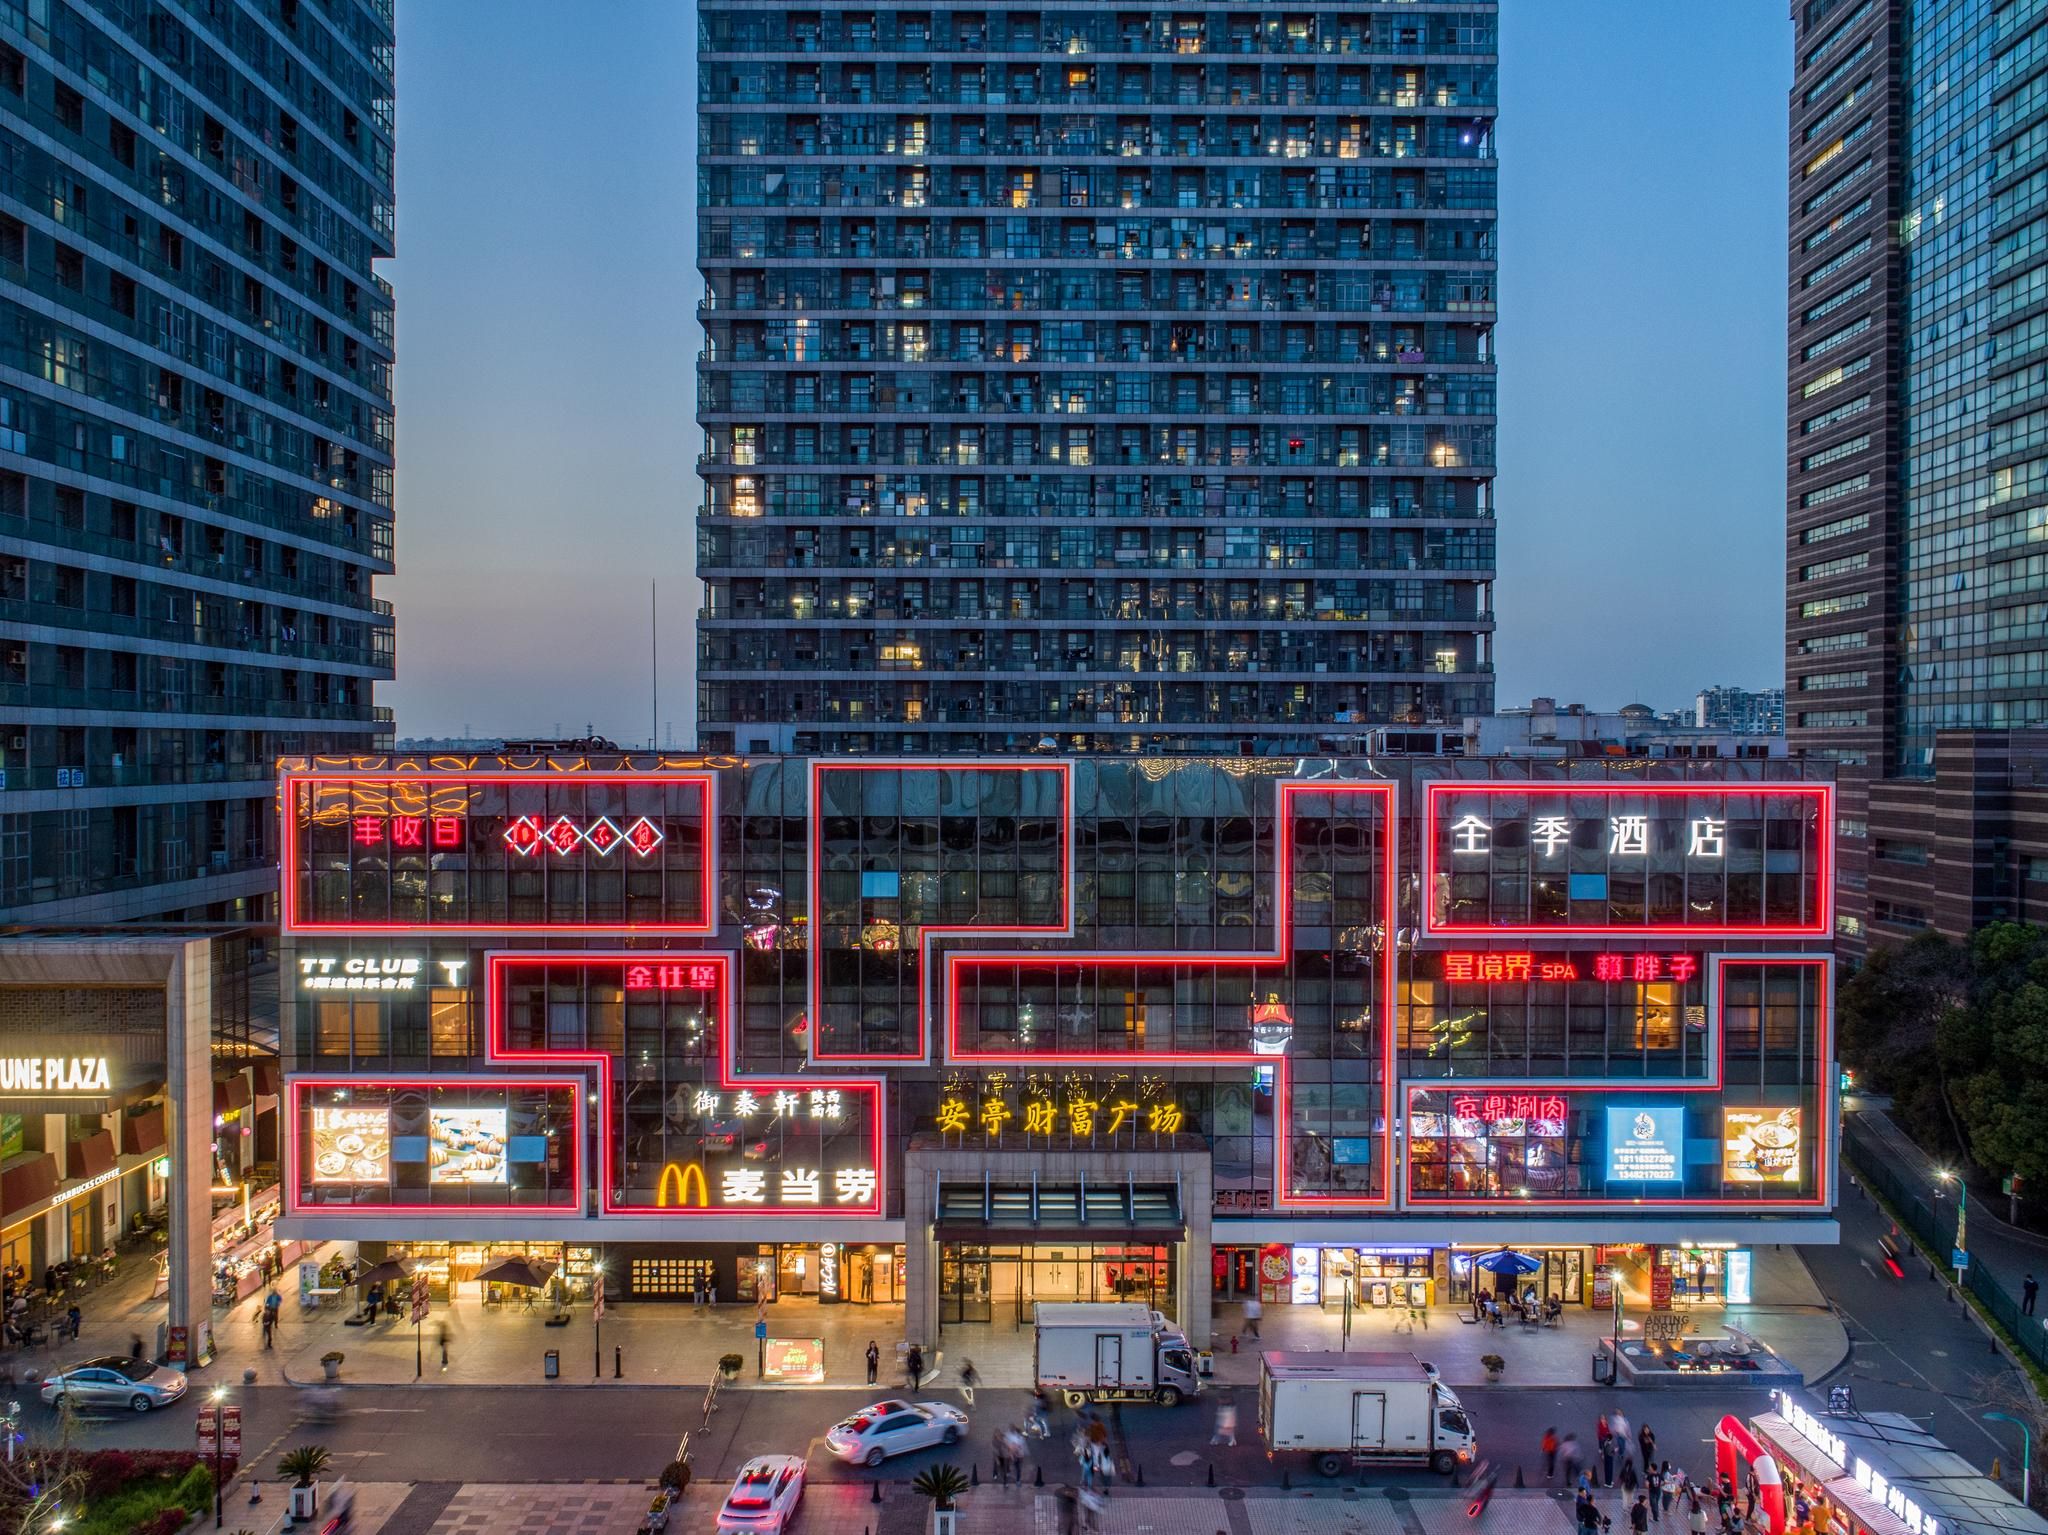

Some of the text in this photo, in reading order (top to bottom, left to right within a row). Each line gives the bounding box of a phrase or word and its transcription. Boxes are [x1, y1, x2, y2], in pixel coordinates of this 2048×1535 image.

[354, 815, 467, 846] 丰收日
[510, 816, 655, 854] 川流不息
[1451, 815, 1726, 857] 全季酒店
[299, 958, 421, 974] TT CLUB
[627, 965, 716, 988] 金仕堡
[1446, 954, 1575, 980] 星境界 SPA
[46, 1058, 110, 1090] PLAZA
[936, 1098, 1183, 1136] 安亭财富广场
[1454, 1095, 1567, 1121] 京鼎涮肉
[52, 1167, 120, 1205] STARBUCKS COFFEE
[722, 1168, 876, 1203] 麦当劳
[1645, 1323, 1701, 1333] FORTUE
[1646, 1315, 1689, 1325] ANTING
